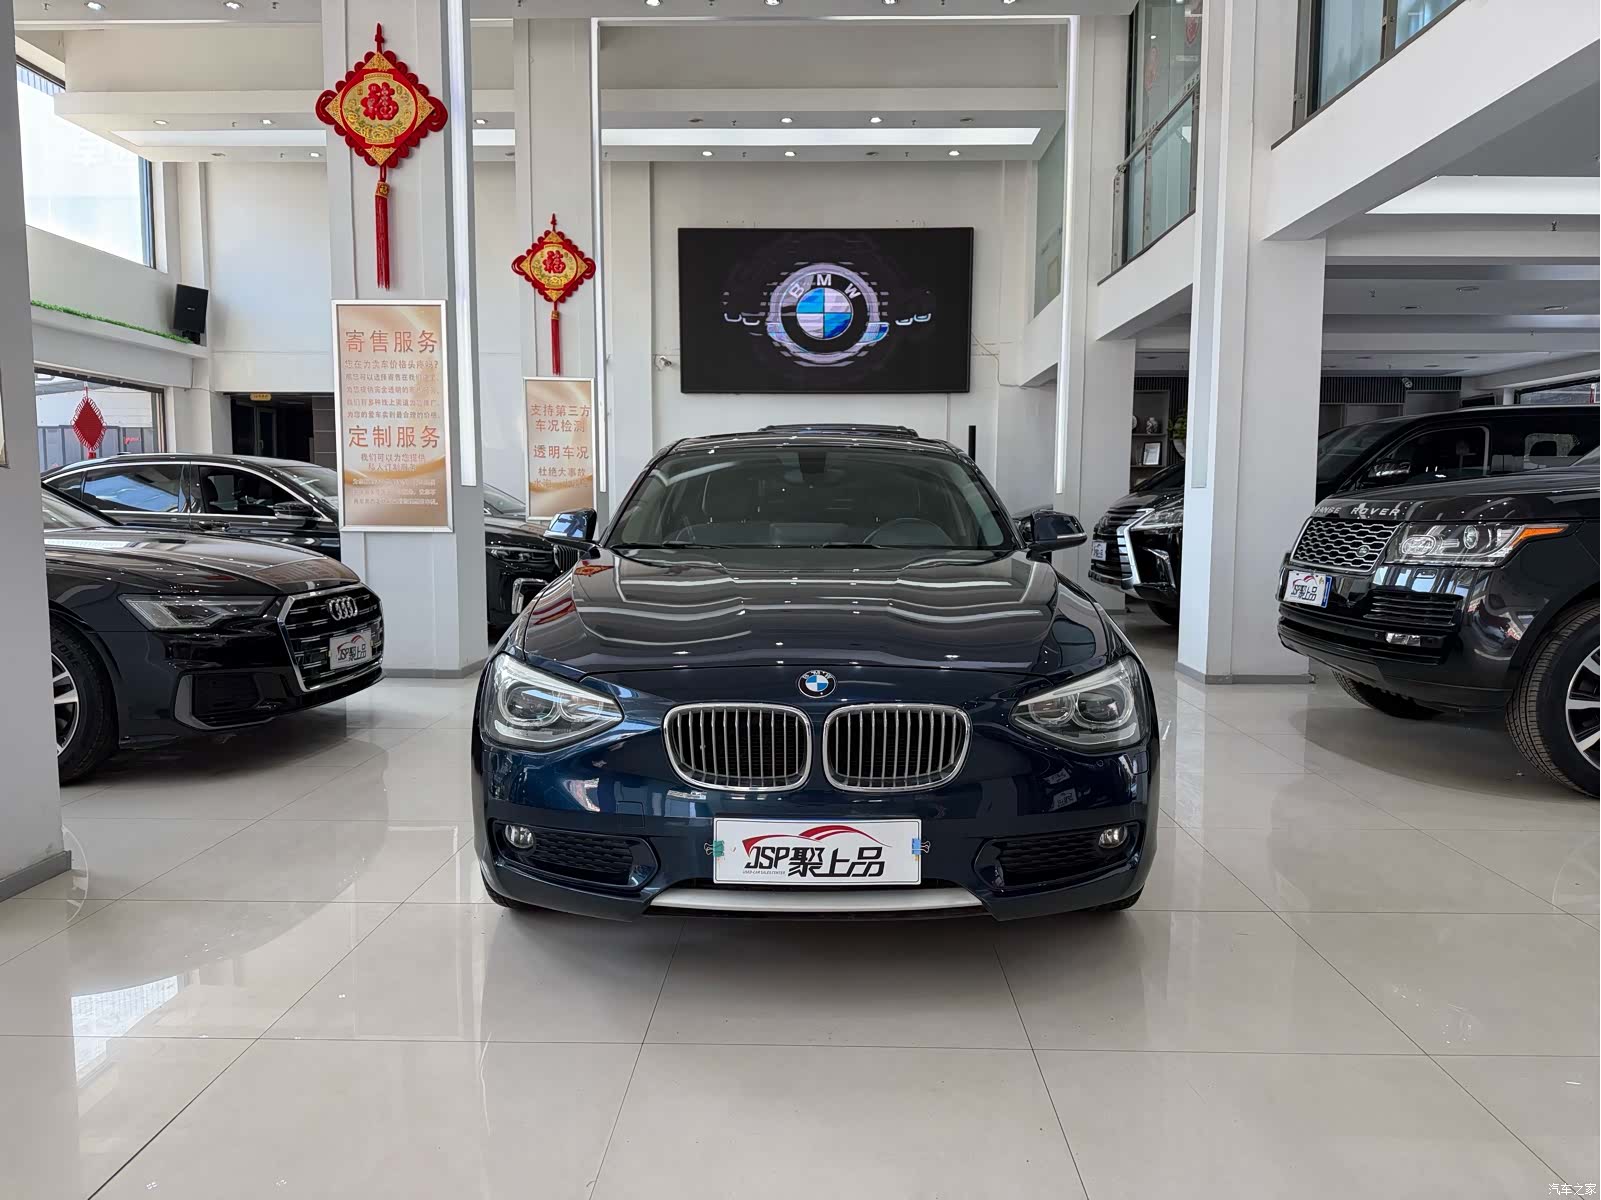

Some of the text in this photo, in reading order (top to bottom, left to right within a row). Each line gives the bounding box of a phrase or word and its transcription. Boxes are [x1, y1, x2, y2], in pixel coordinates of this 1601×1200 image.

[361, 82, 399, 121] 福
[542, 250, 567, 274] 福
[789, 273, 862, 301] BMW
[345, 330, 438, 354] 寄售服务
[530, 404, 591, 417] 支持第三方
[348, 425, 440, 448] 定制服务
[535, 419, 585, 433] 车况检测
[533, 445, 589, 460] 透明车况
[538, 467, 586, 477] 杜绝大事故
[1350, 507, 1401, 516] ROVER
[744, 846, 885, 877] JSP 聚上品
